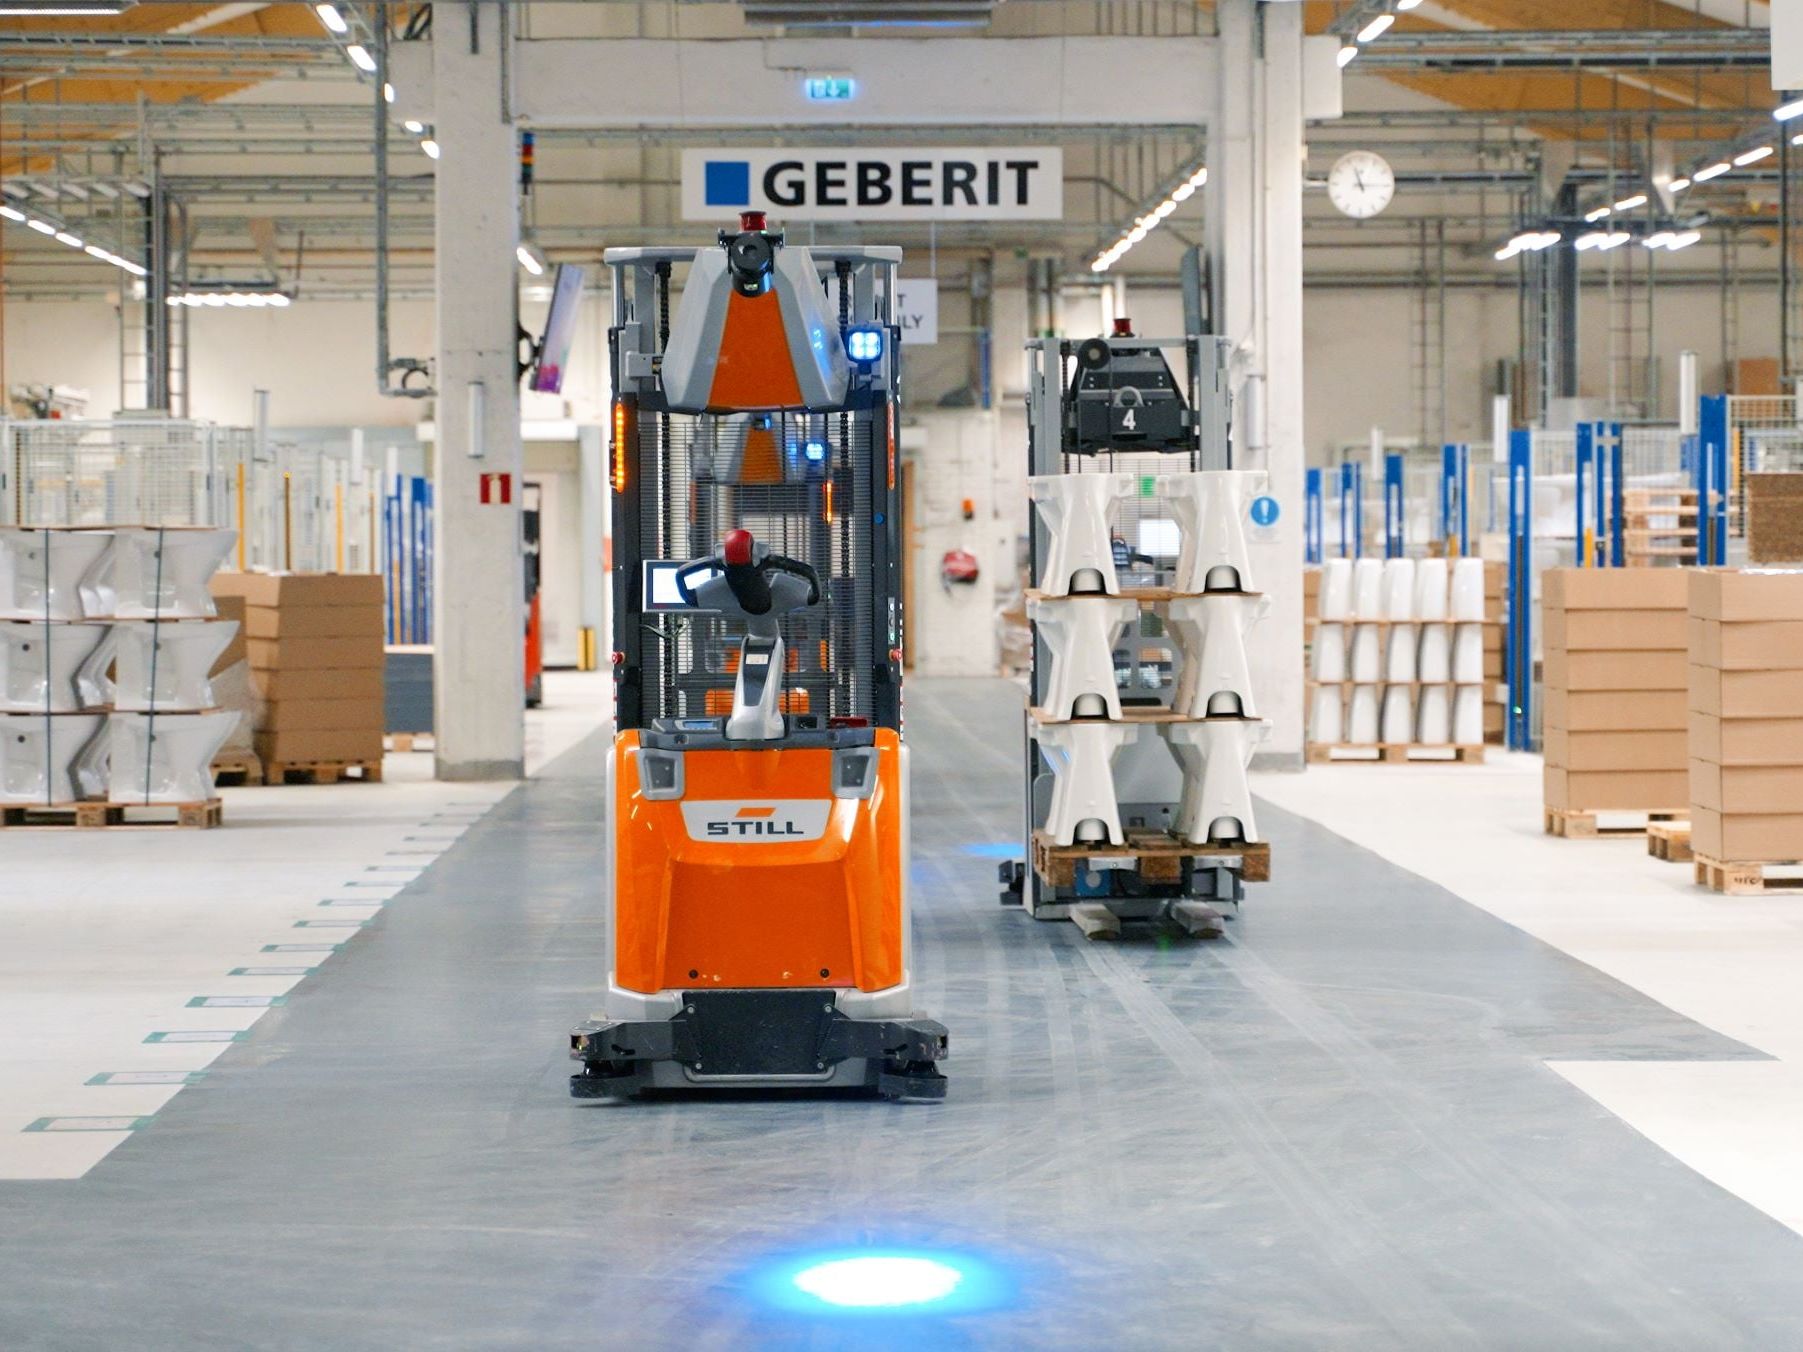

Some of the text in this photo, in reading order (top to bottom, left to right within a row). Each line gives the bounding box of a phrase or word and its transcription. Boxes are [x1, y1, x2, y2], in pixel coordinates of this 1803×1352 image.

[762, 160, 1040, 207] GEBERIT
[1122, 408, 1136, 430] 4
[707, 821, 804, 836] STILL
